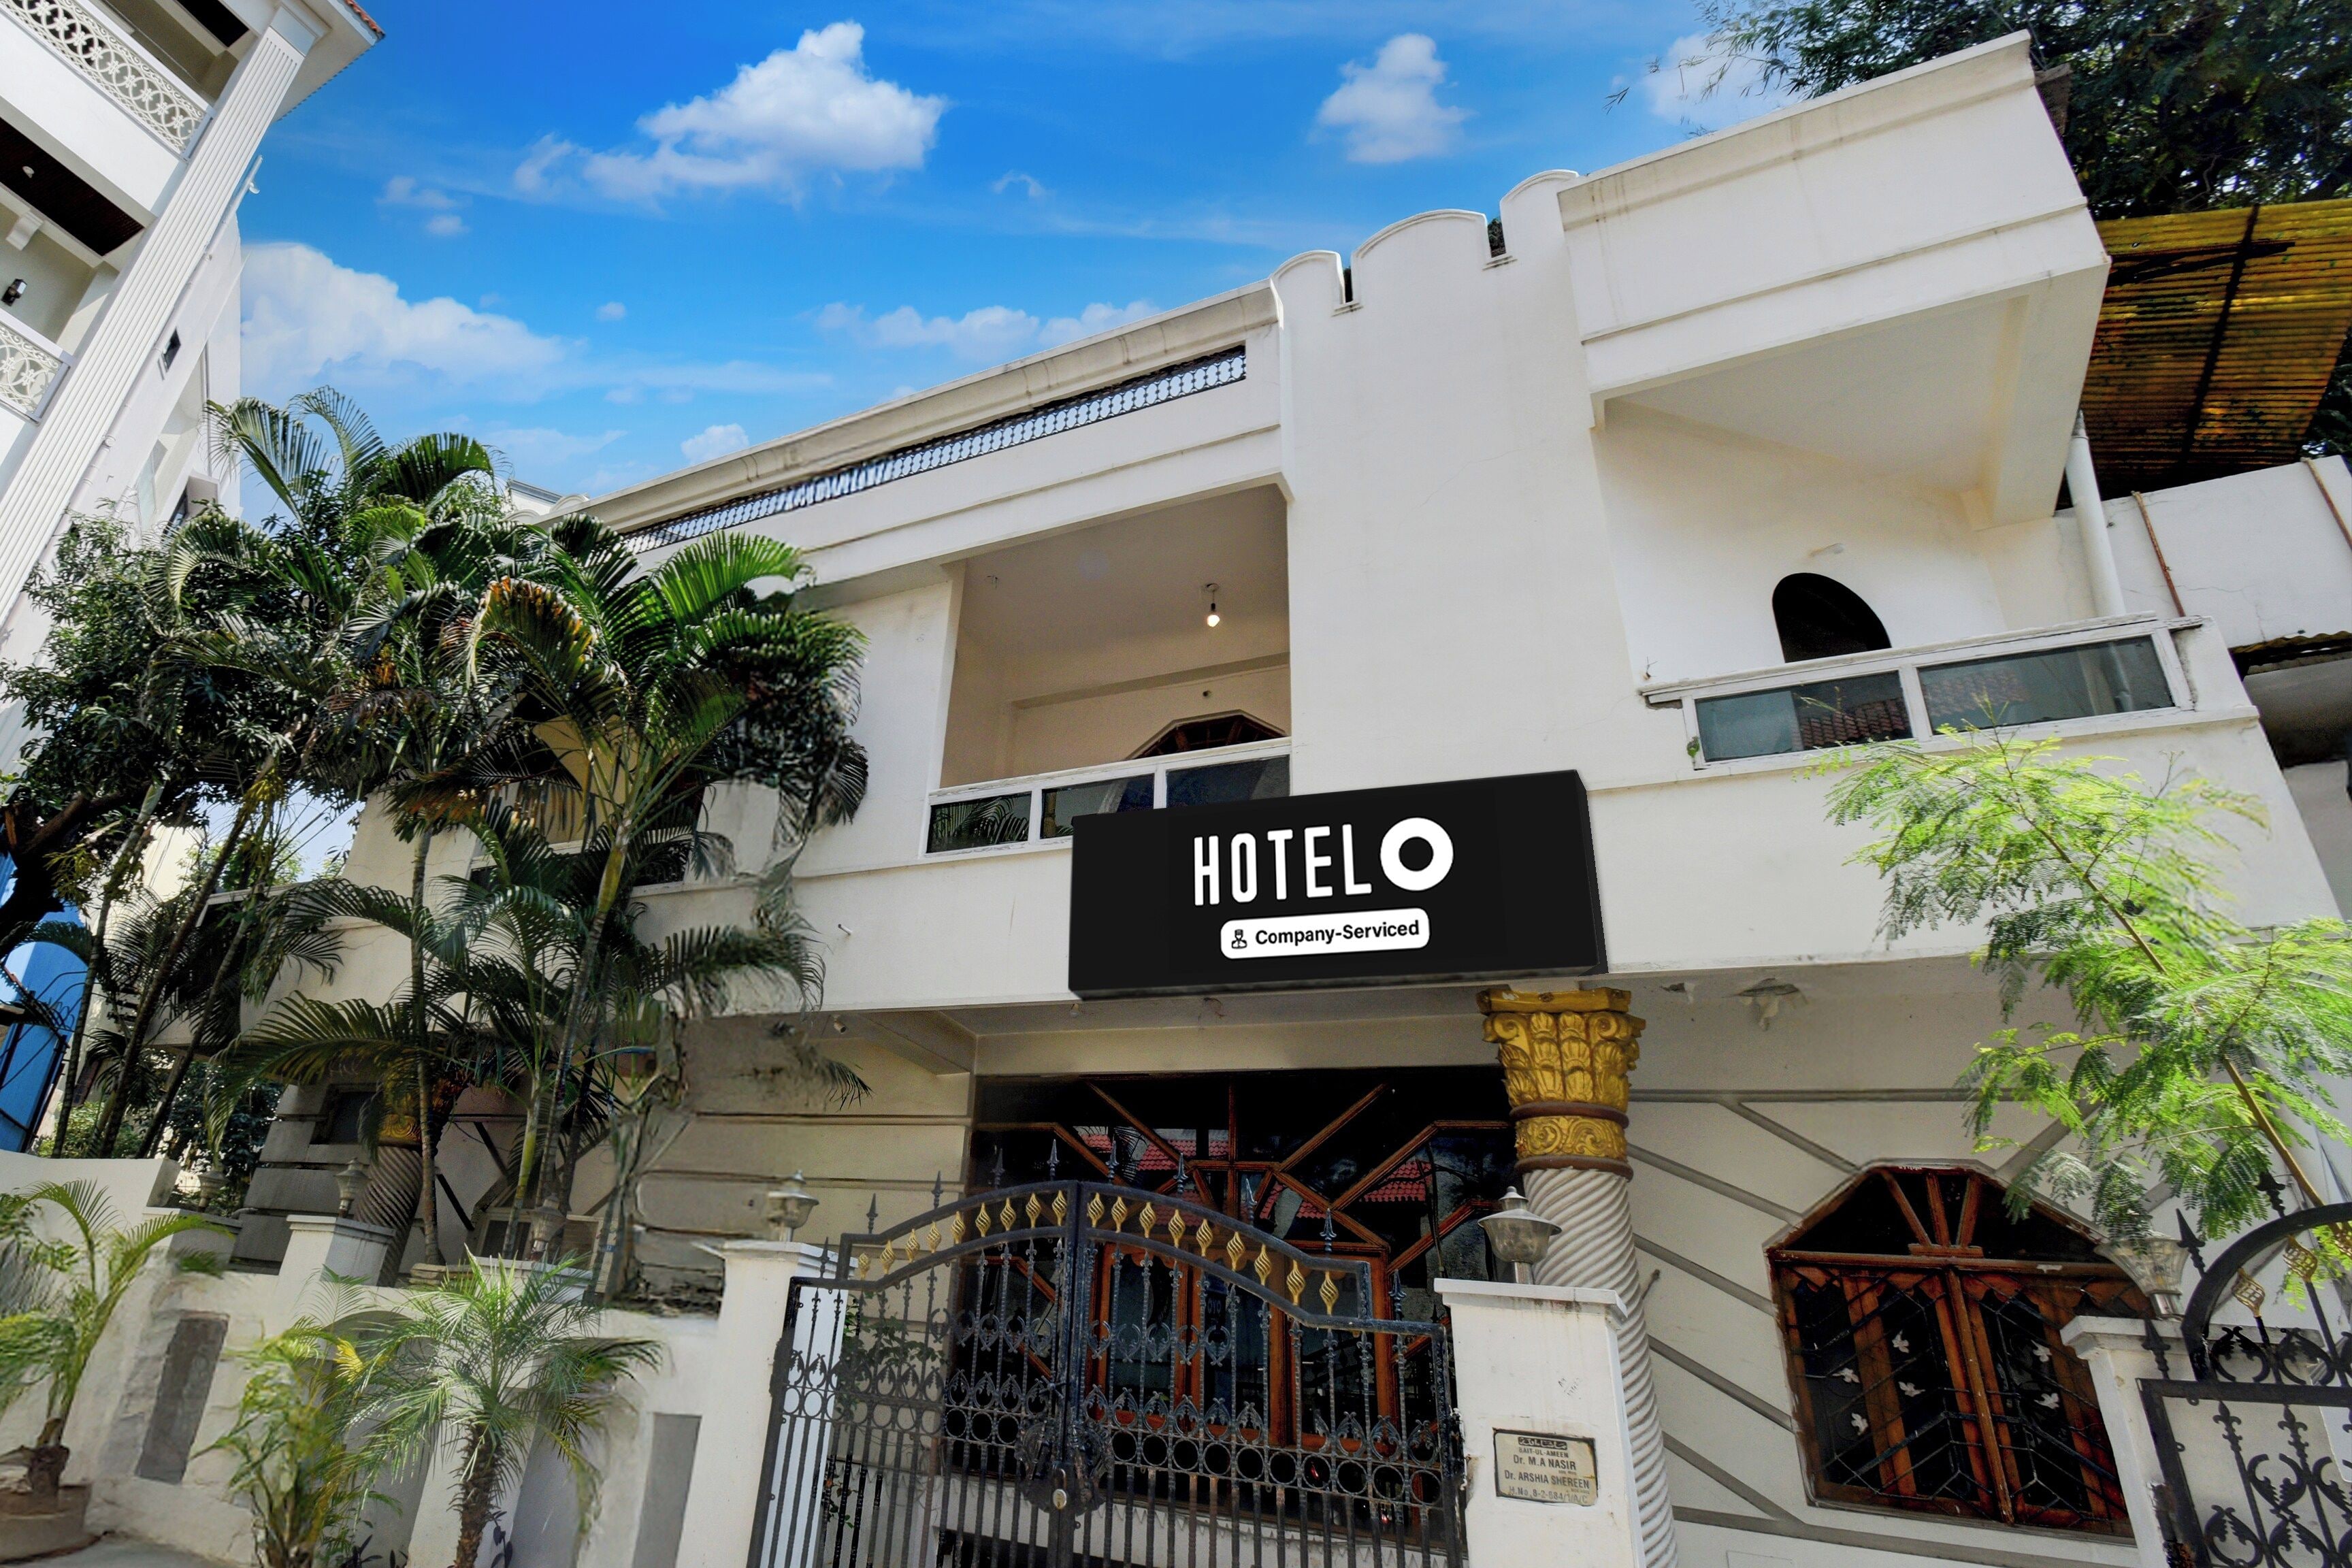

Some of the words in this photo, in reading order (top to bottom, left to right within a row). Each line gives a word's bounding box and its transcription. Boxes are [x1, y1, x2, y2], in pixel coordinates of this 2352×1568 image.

[1194, 823, 1372, 906] HOTEL
[1379, 817, 1454, 891] O
[1255, 920, 1420, 947] Company-Serviced
[1514, 1454, 1525, 1465] Dr.
[1548, 1458, 1576, 1470] NASIR
[1504, 1470, 1516, 1480] Dr.
[1518, 1472, 1549, 1484] ARSHIA
[1551, 1475, 1590, 1489] SHEREEN
